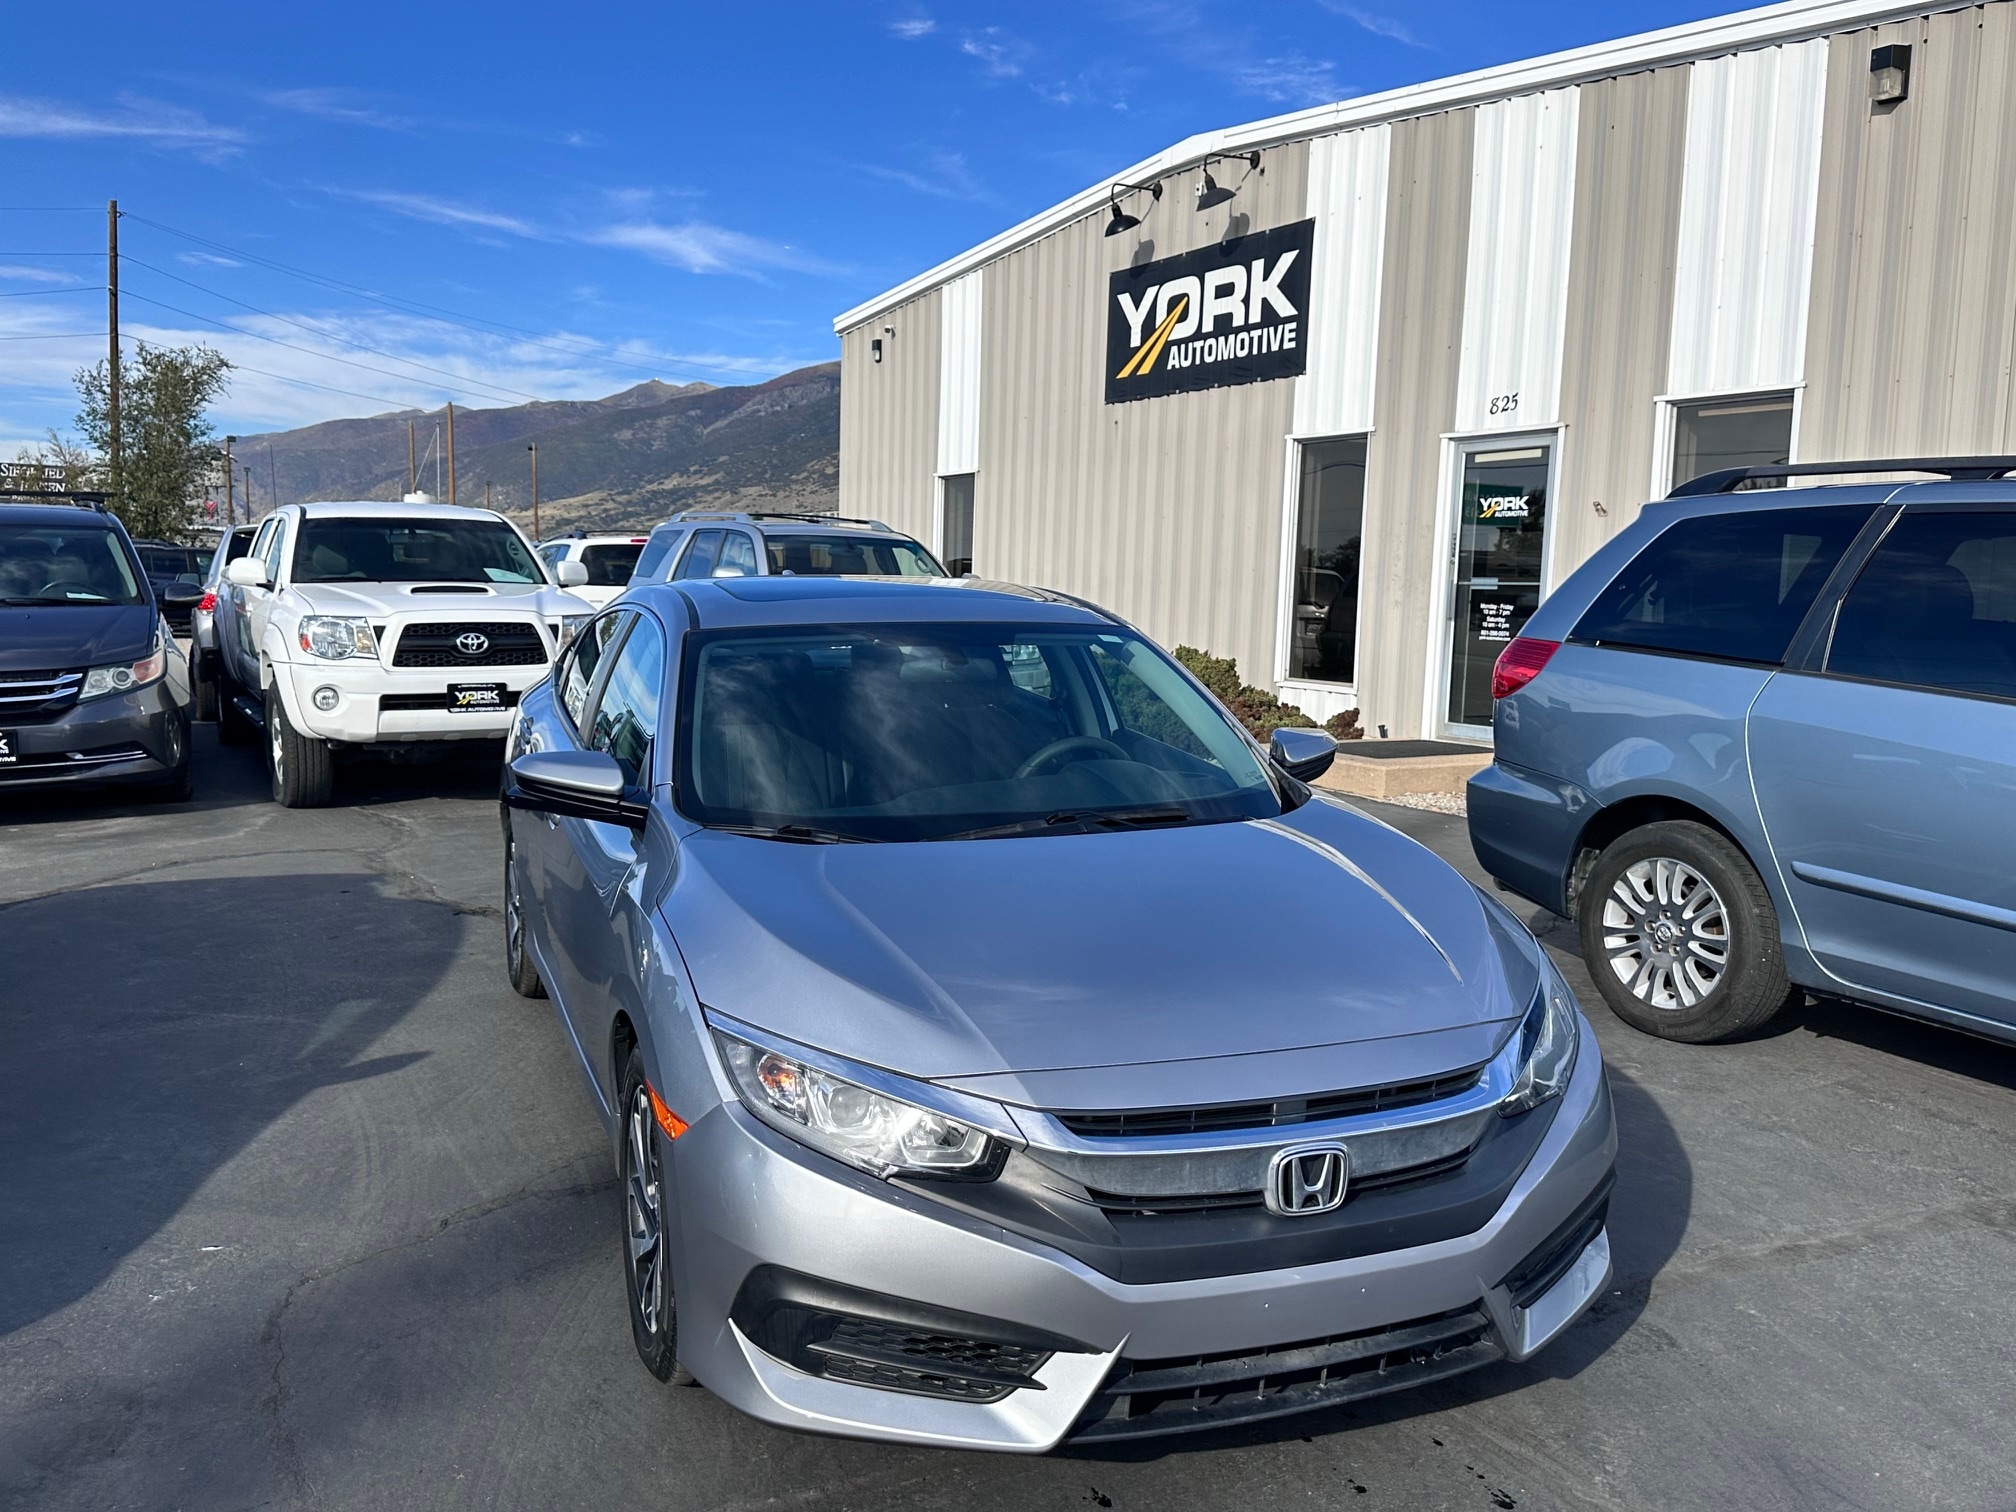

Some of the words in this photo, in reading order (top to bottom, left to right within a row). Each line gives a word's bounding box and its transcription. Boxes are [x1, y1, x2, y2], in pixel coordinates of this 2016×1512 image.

[1117, 249, 1300, 348] YORK
[1167, 322, 1297, 370] AUTOMOTIVE
[1490, 391, 1518, 415] 825
[1479, 496, 1529, 511] YORK
[454, 690, 499, 701] YORK
